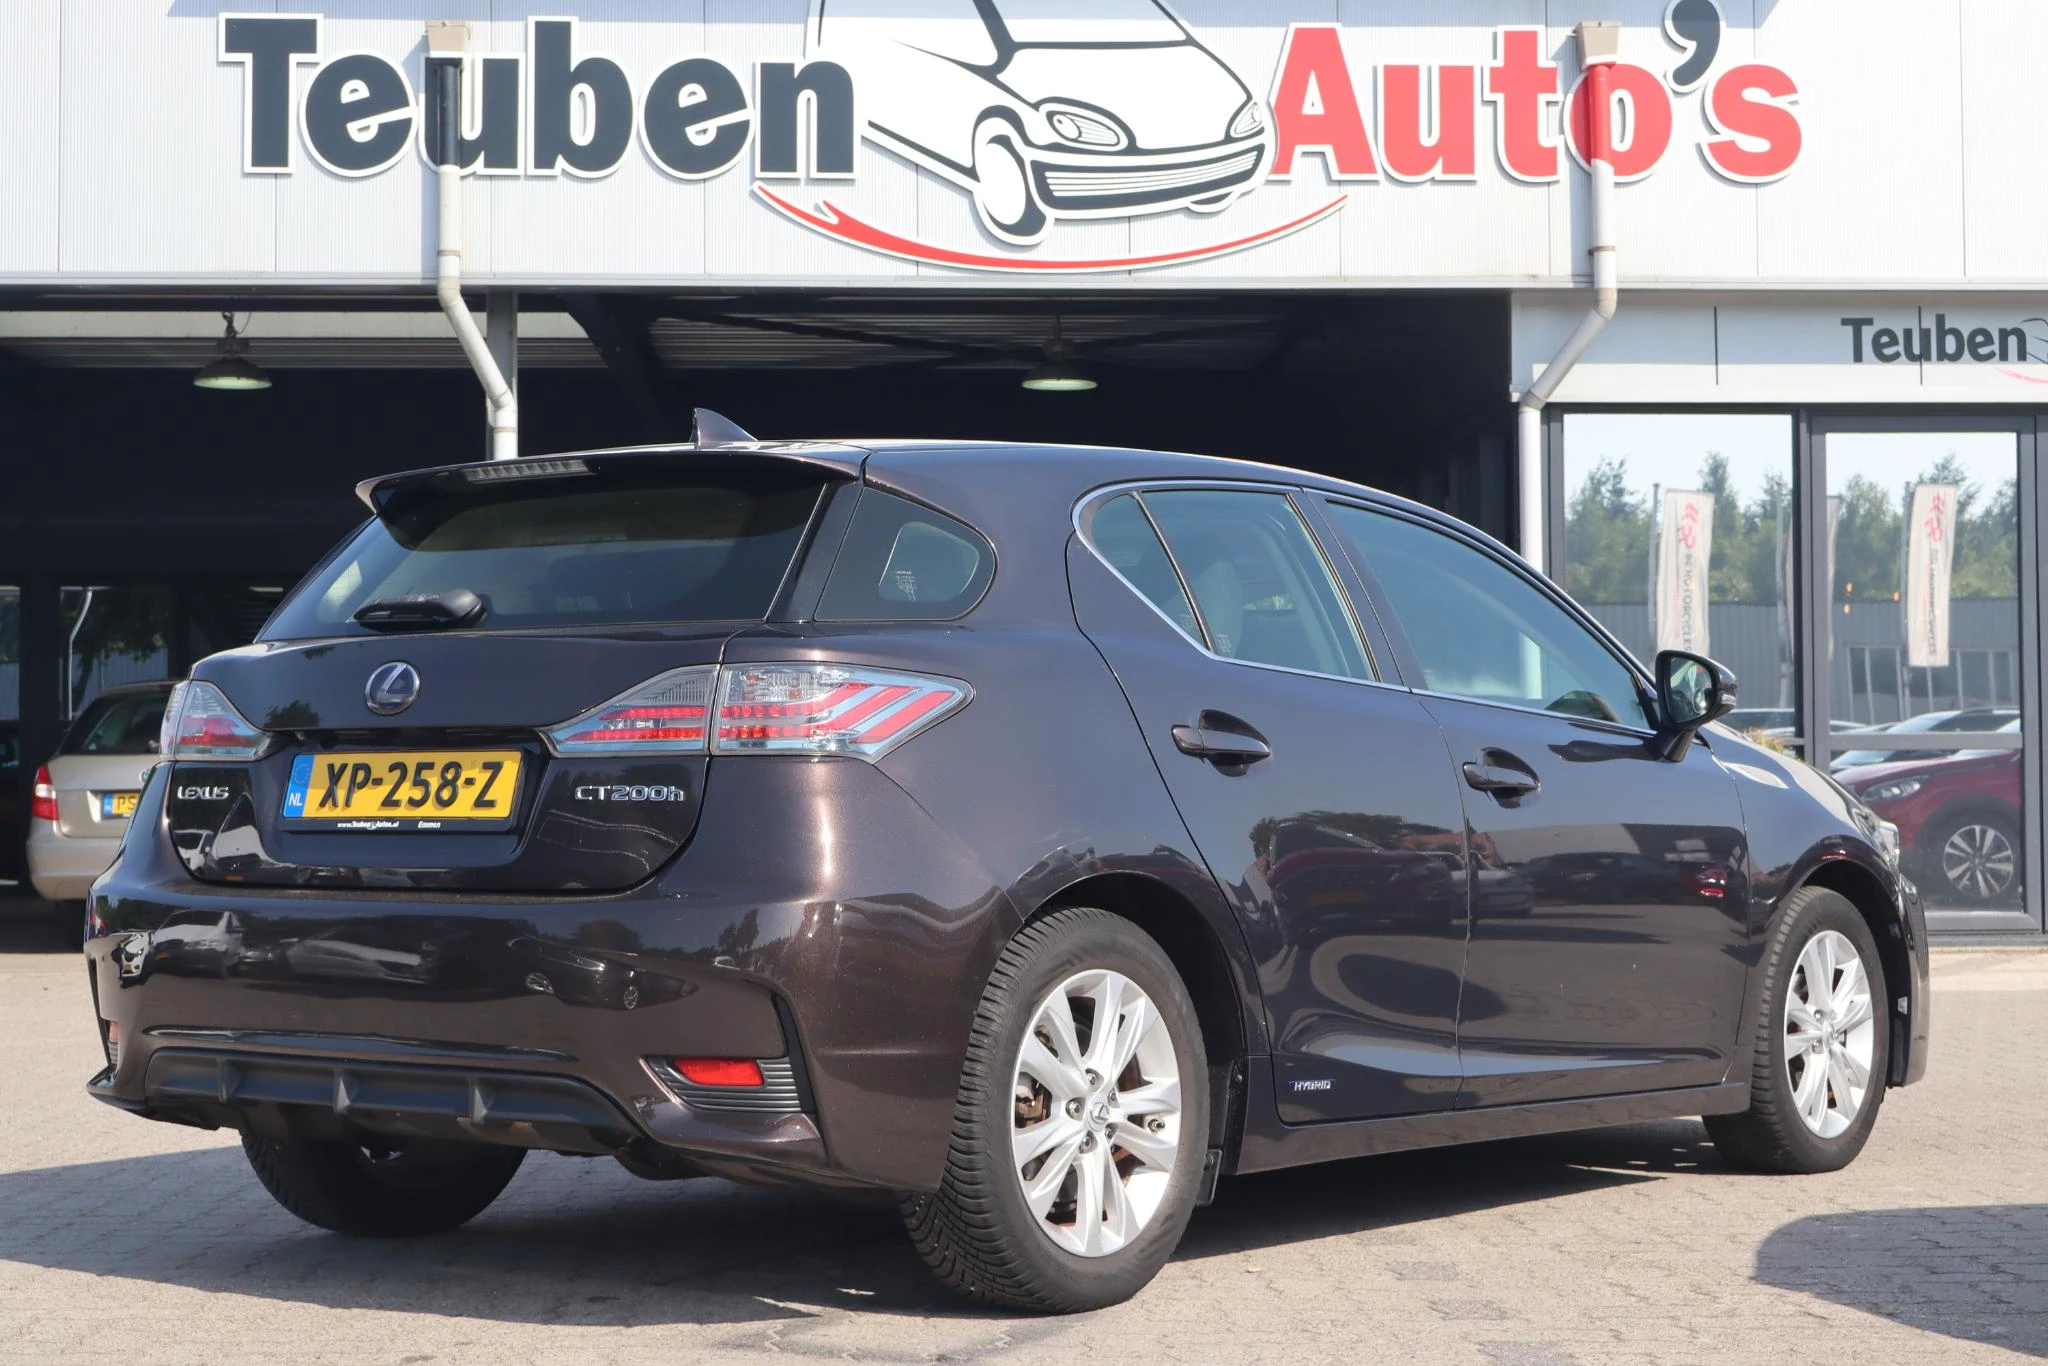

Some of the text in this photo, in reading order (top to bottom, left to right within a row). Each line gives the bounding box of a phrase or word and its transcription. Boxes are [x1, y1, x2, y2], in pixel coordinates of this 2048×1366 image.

[220, 0, 1803, 184] Teuben Auto's
[1840, 313, 2027, 363] Teuben
[177, 785, 229, 800] LEXUS
[288, 792, 303, 807] NL
[318, 760, 504, 809] XP-258-Z
[1294, 1080, 1332, 1092] HYBRID
